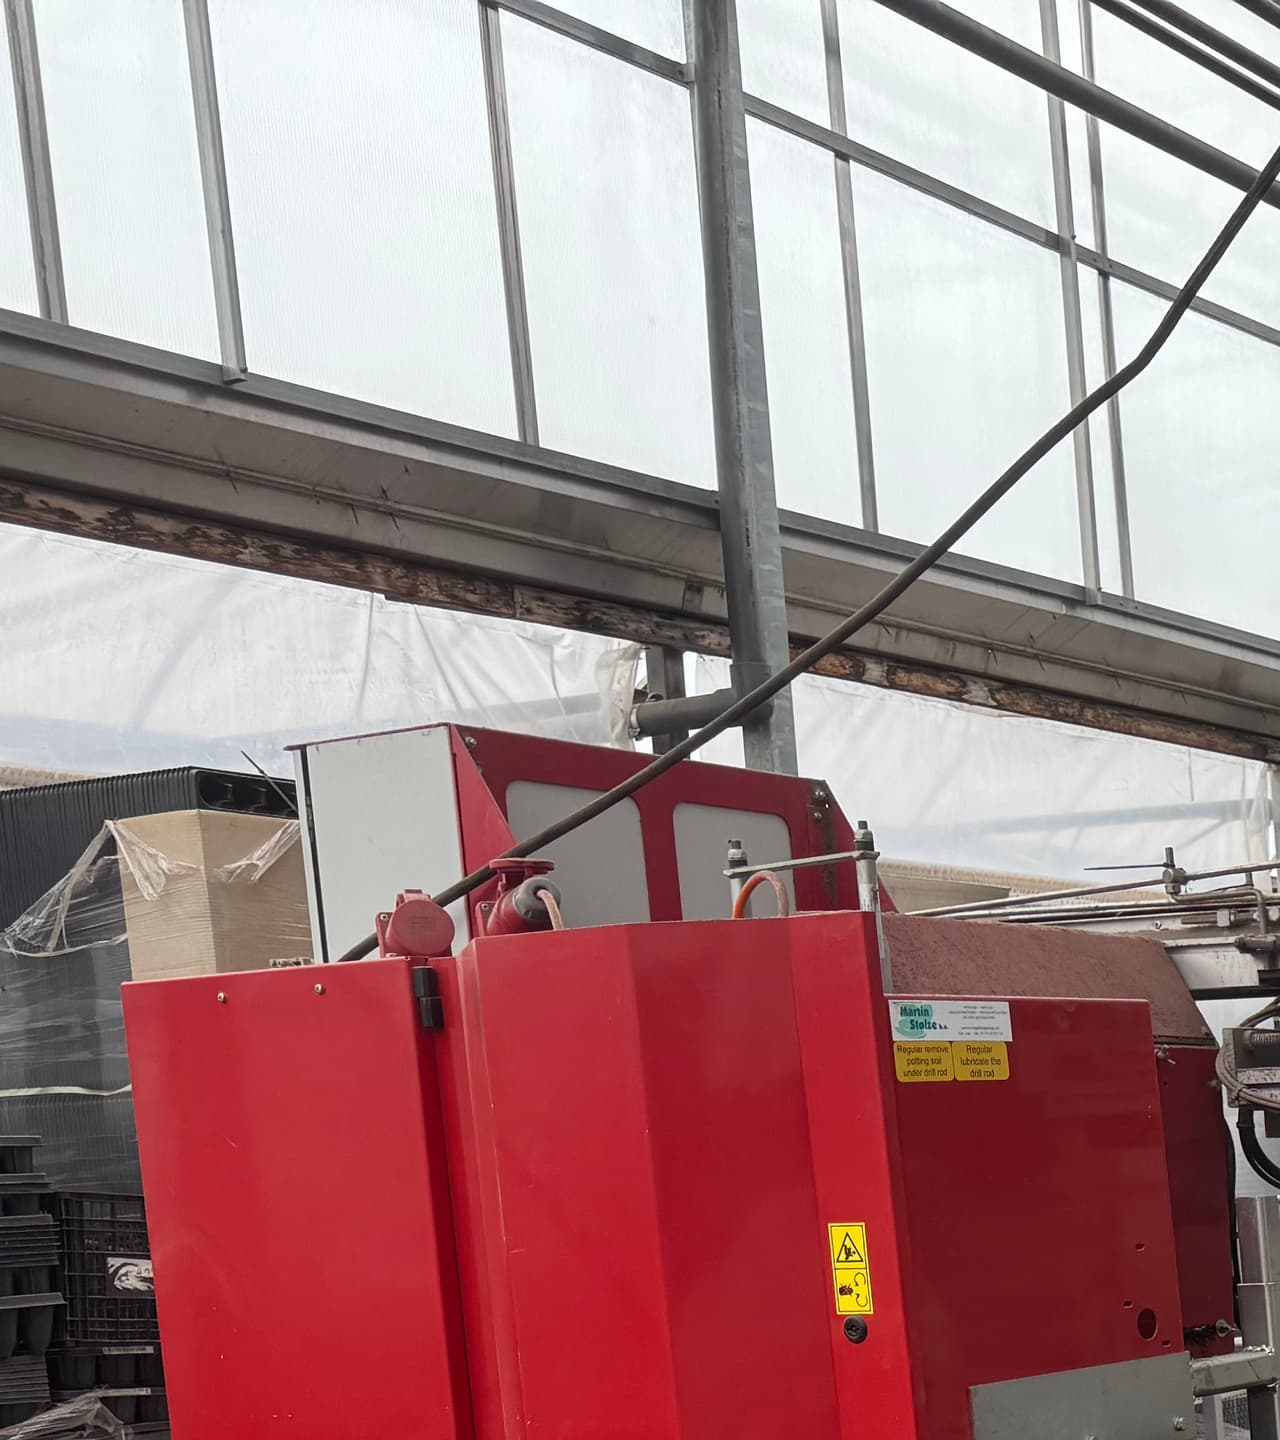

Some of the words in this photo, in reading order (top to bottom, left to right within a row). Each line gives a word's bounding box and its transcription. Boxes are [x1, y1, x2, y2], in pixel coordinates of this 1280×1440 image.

[900, 1005, 930, 1017] Martin
[909, 1019, 938, 1030] Stolze
[897, 1045, 923, 1056] Regular
[924, 1046, 949, 1054] remove
[966, 1045, 993, 1055] Regular
[906, 1058, 929, 1066] potting
[930, 1057, 942, 1065] soil
[960, 1057, 989, 1066] lubricate
[991, 1057, 1001, 1065] the
[903, 1069, 923, 1077] under
[923, 1068, 936, 1077] drill
[937, 1068, 948, 1077] rod
[970, 1070, 982, 1078] drill
[983, 1070, 995, 1078] rod
